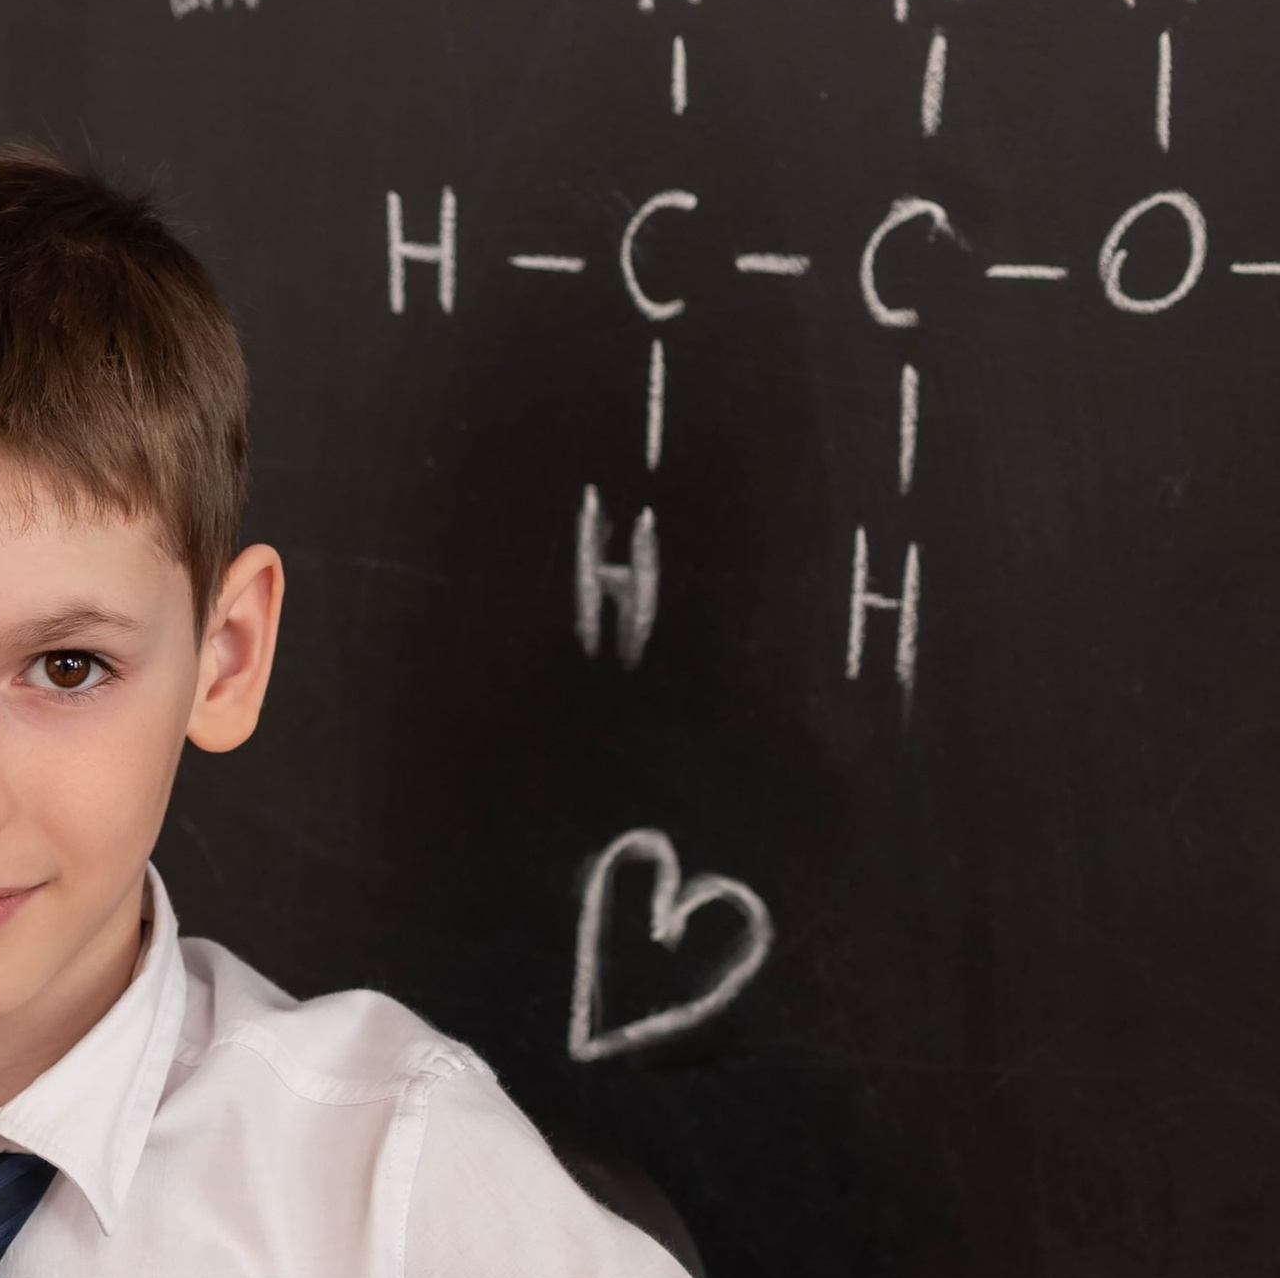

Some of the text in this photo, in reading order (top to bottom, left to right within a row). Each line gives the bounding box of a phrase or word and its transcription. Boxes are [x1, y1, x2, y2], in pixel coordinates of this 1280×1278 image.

[385, 186, 1207, 328] H C C O
[575, 482, 920, 684] H H
